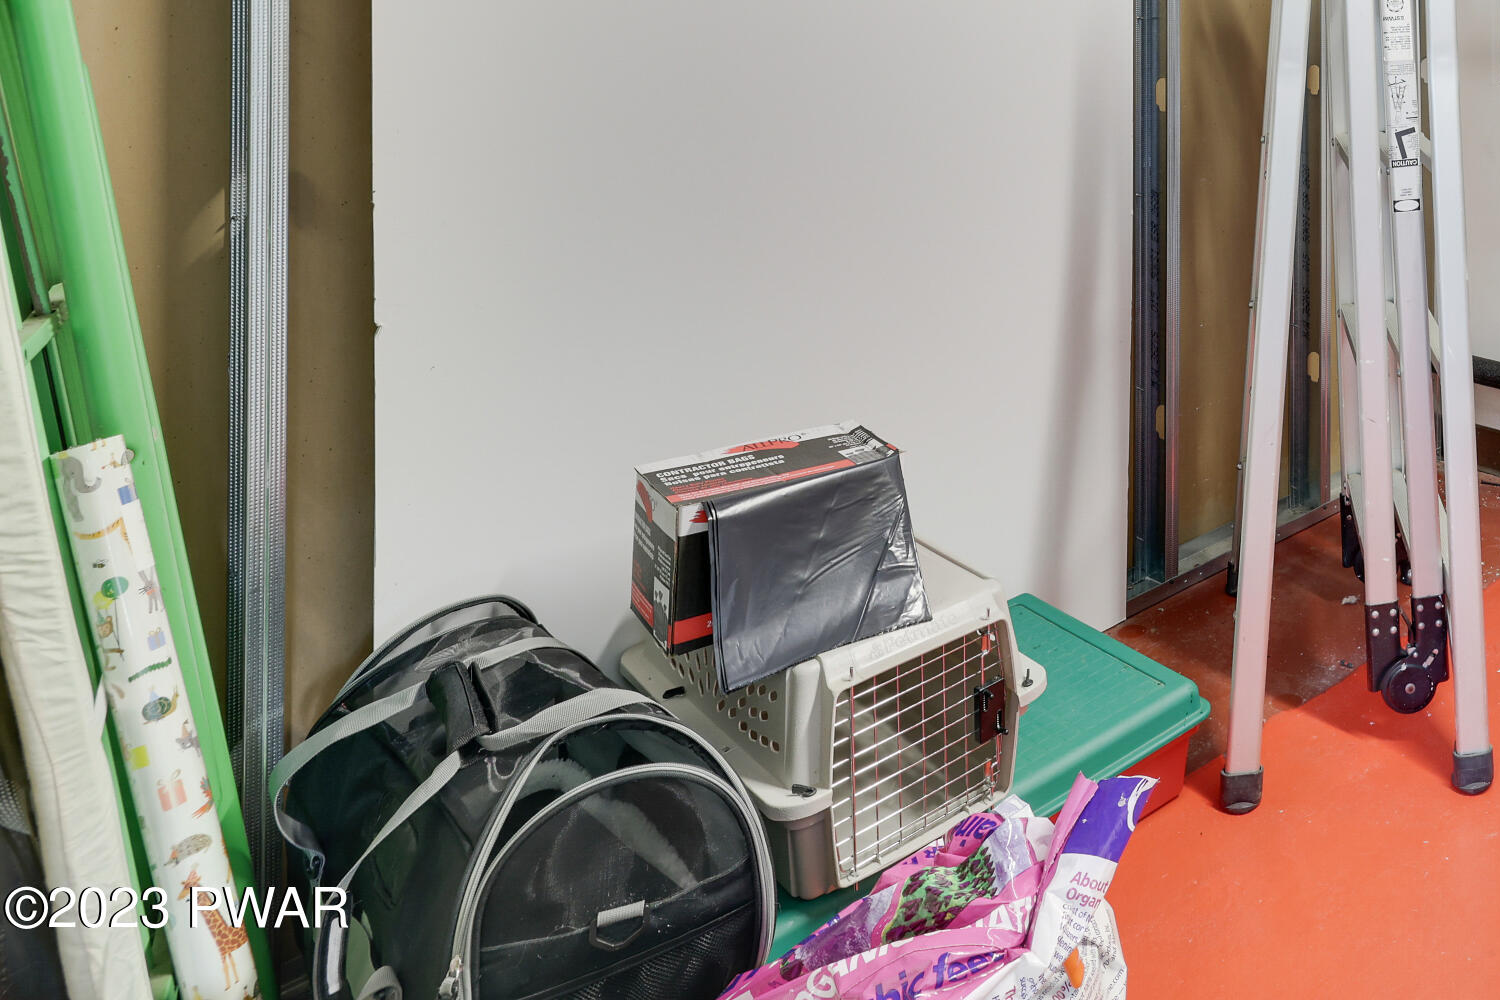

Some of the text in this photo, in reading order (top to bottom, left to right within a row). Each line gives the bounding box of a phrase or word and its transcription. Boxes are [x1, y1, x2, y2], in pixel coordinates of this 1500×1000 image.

[1392, 159, 1419, 167] CAUTION
[656, 454, 756, 479] CONTRACTOR BAGS
[1070, 871, 1109, 894] About
